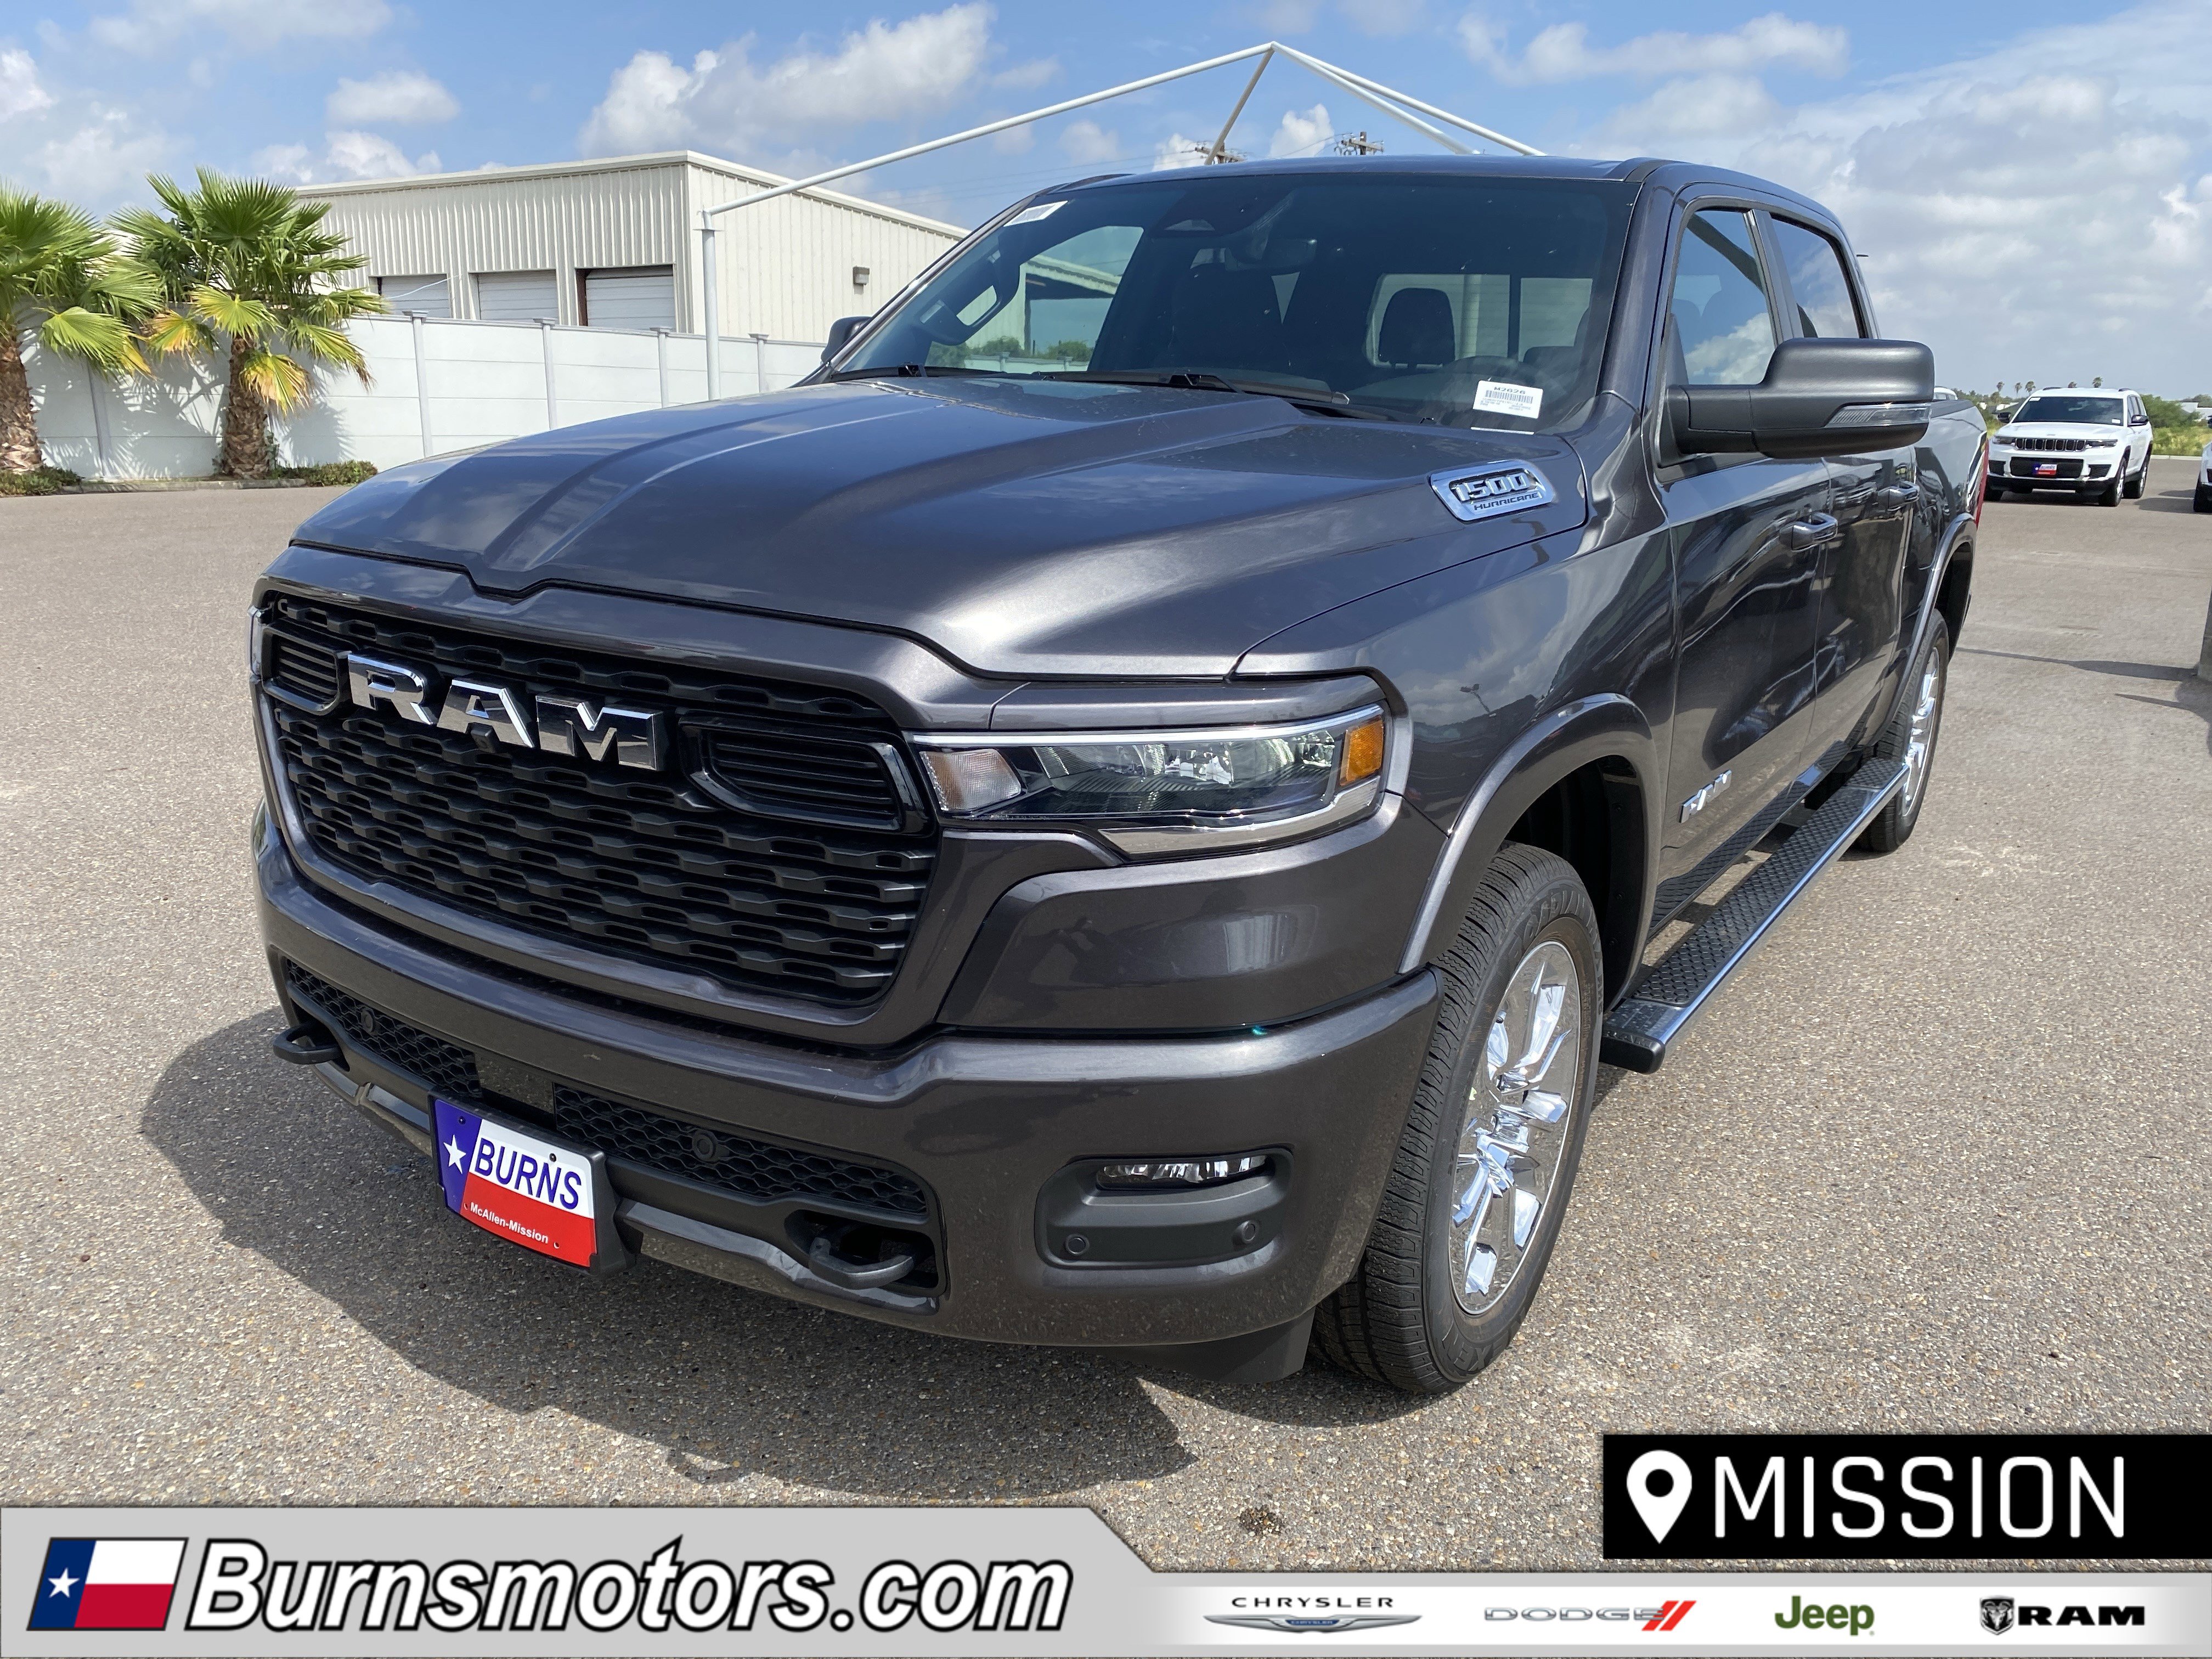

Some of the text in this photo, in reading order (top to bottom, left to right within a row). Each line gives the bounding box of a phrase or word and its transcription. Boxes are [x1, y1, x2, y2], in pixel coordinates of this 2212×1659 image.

[1452, 472, 1532, 503] 1500
[1474, 492, 1538, 511] HURRICANE
[348, 654, 658, 771] RAM
[474, 1137, 582, 1210] BURNS
[470, 1201, 549, 1244] McAllen-Mission
